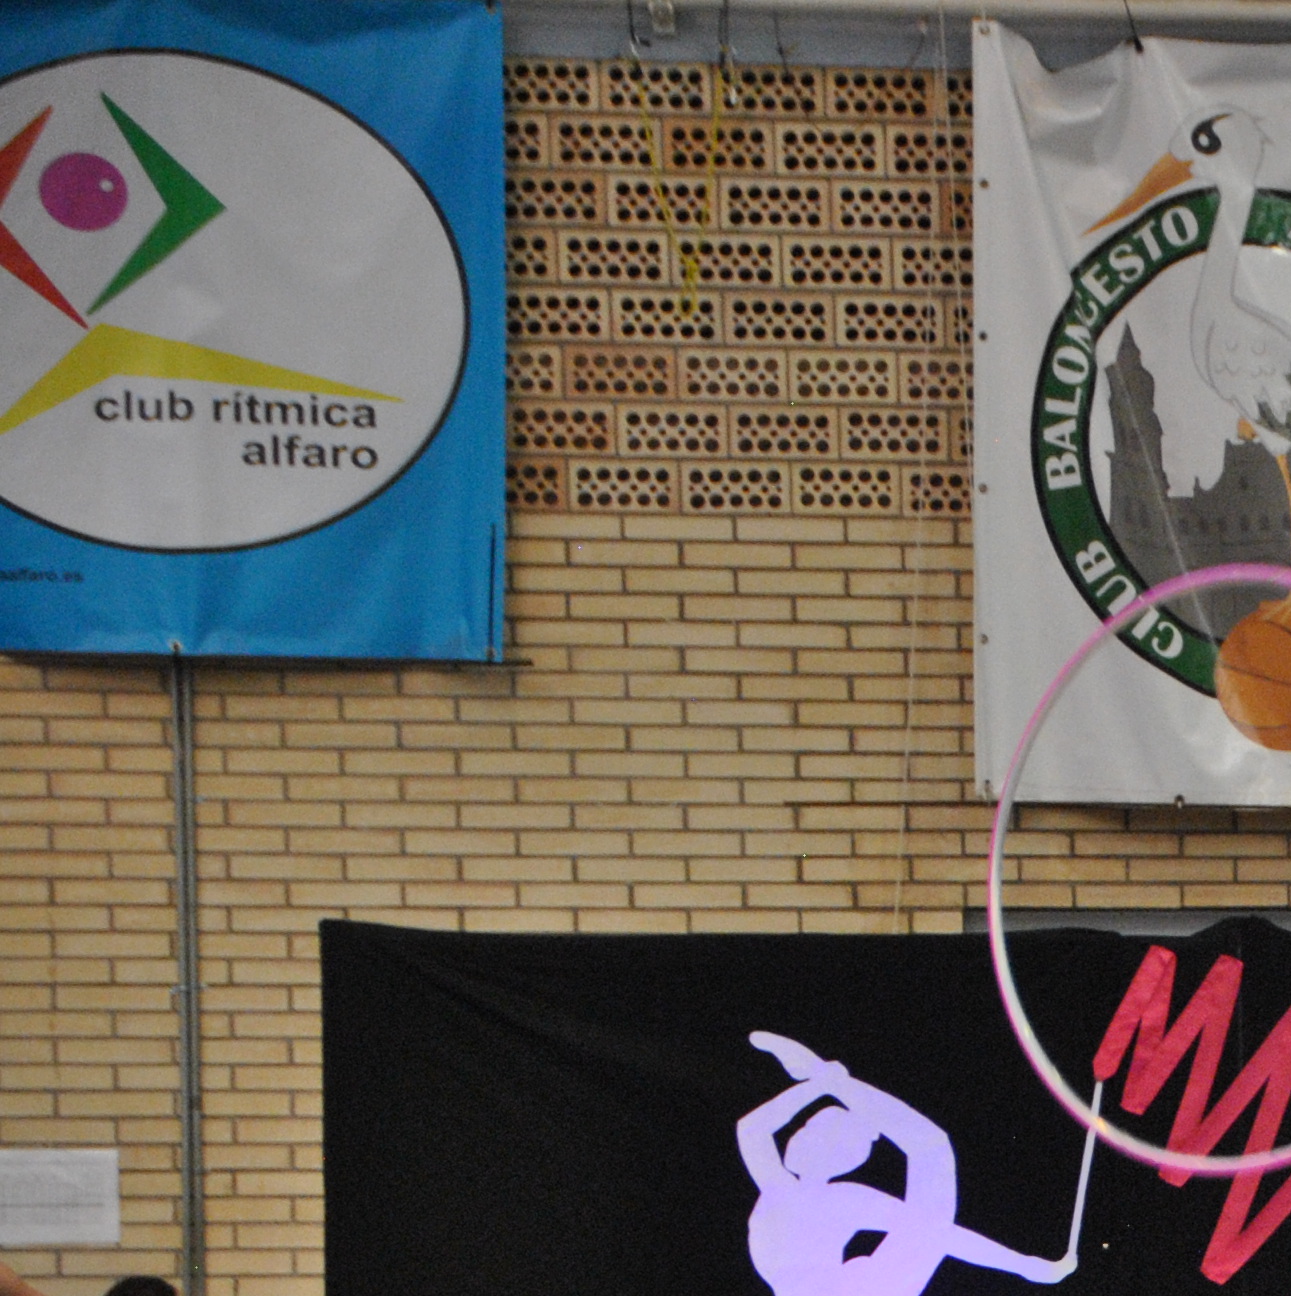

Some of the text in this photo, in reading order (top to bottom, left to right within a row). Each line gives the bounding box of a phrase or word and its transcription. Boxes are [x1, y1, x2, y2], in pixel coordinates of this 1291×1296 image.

[94, 390, 378, 429] club rítmica
[241, 434, 379, 470] alfaro
